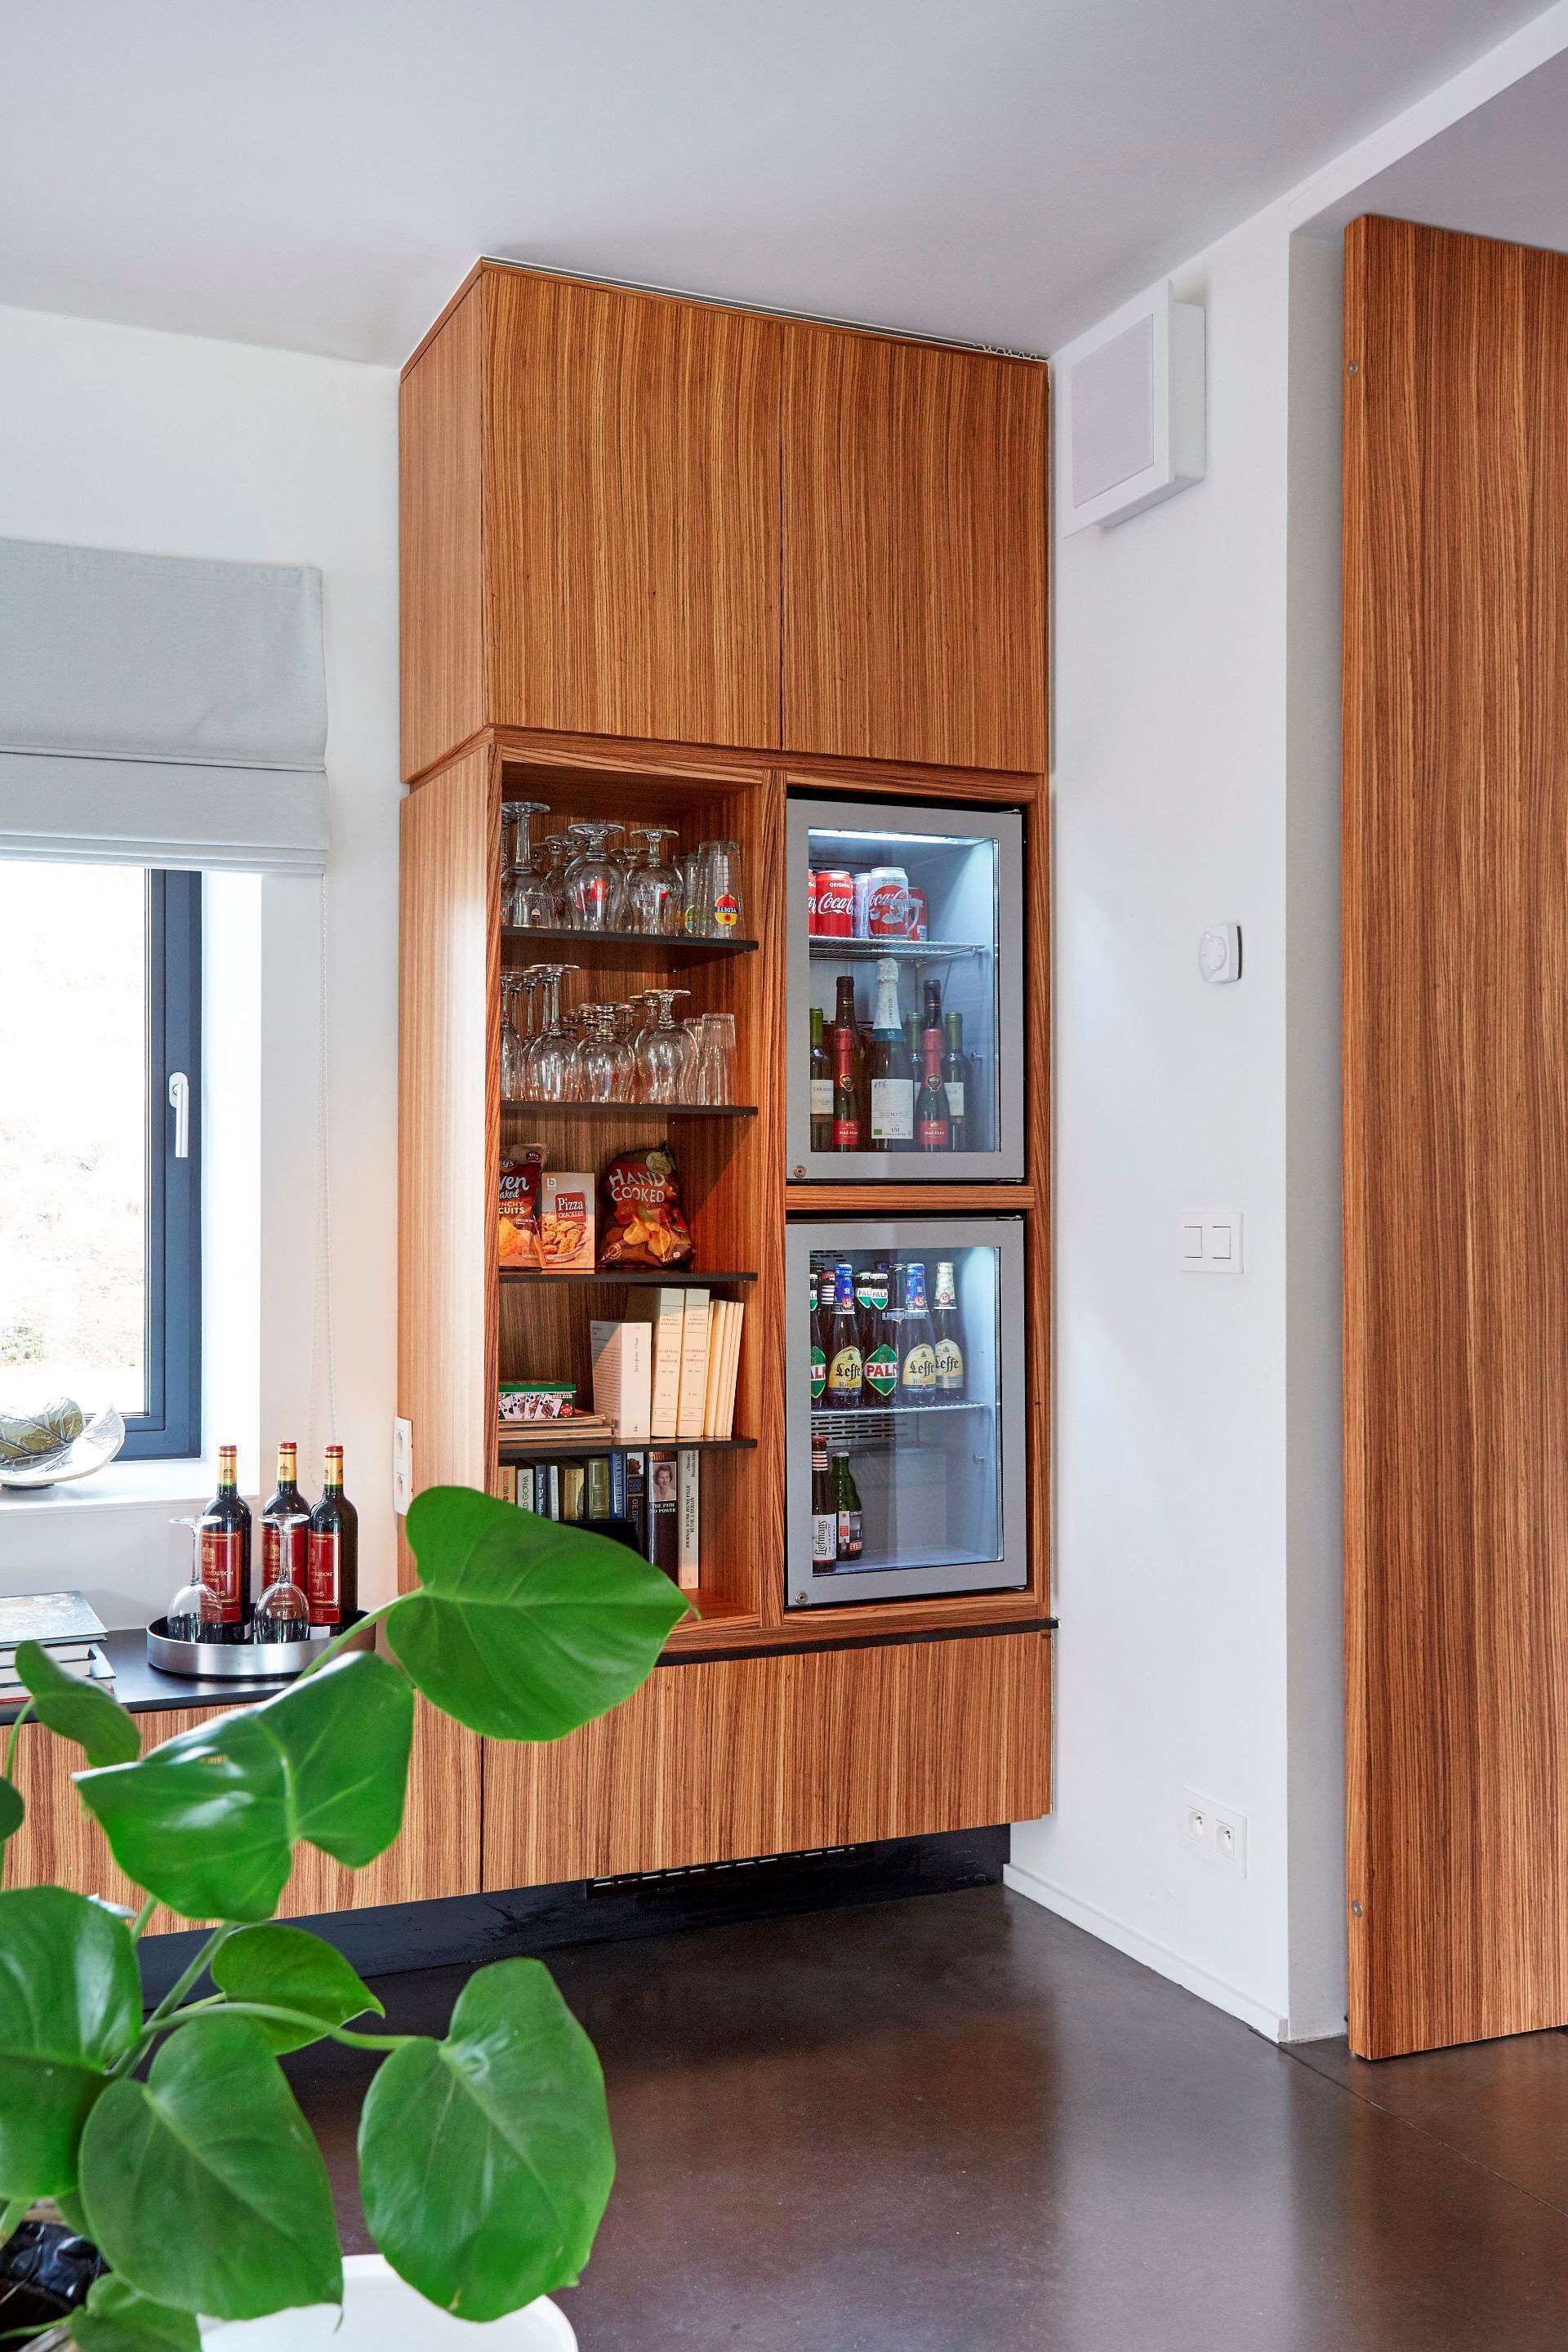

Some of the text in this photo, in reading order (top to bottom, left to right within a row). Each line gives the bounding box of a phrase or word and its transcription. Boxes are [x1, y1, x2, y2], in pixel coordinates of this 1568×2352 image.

[498, 1176, 529, 1190] ven
[608, 1169, 666, 1187] HAND
[499, 1189, 519, 1199] aked
[611, 1186, 666, 1203] COOKED
[557, 1197, 583, 1210] Pizza
[814, 1520, 827, 1555] Liefmans
